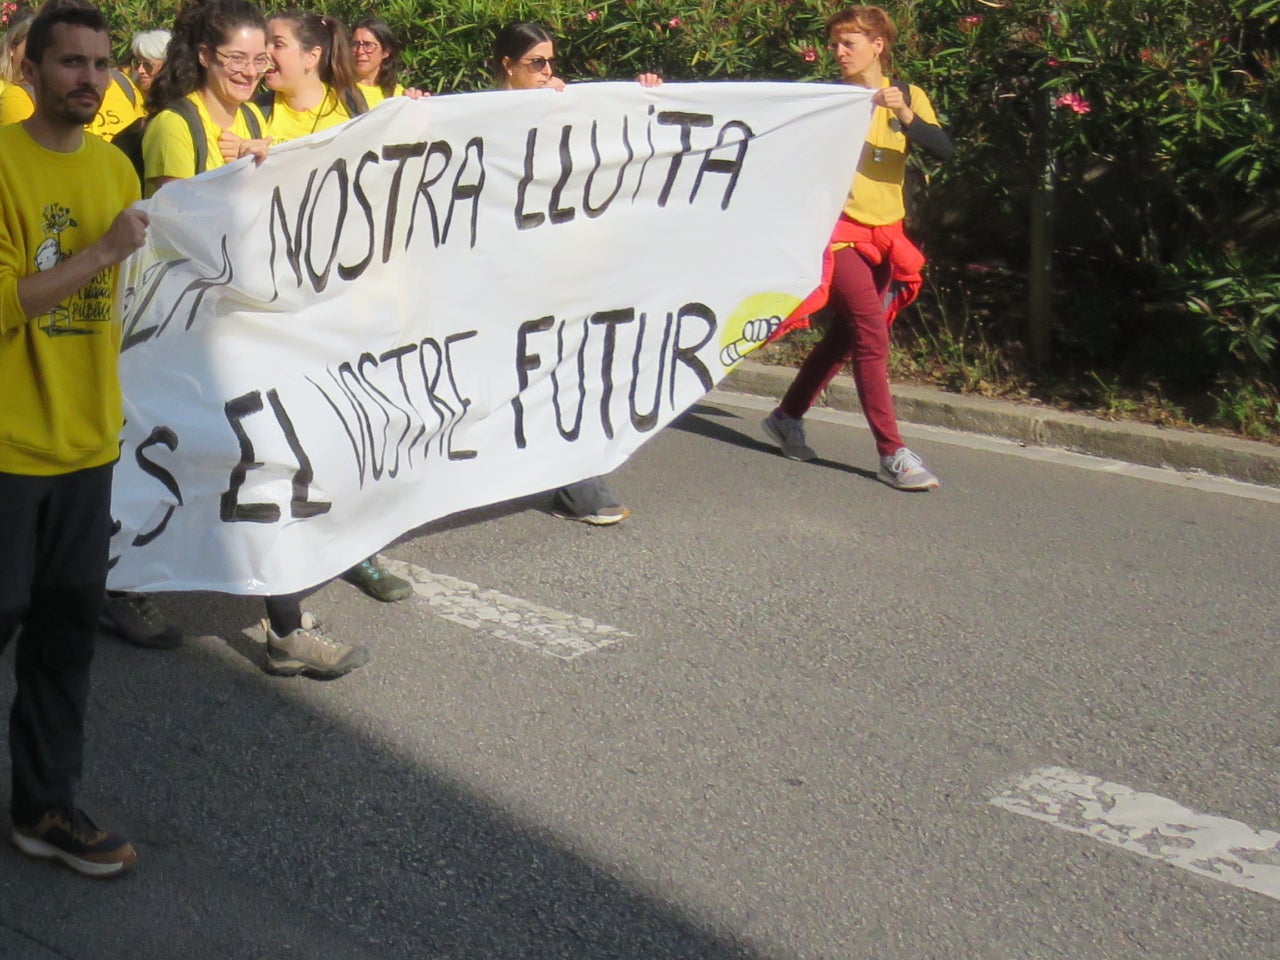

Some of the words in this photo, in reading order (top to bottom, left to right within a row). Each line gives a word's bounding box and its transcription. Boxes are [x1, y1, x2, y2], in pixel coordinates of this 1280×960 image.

[268, 136, 487, 300] NOSTRA
[219, 387, 332, 523] EL
[512, 302, 718, 449] FUTUR
